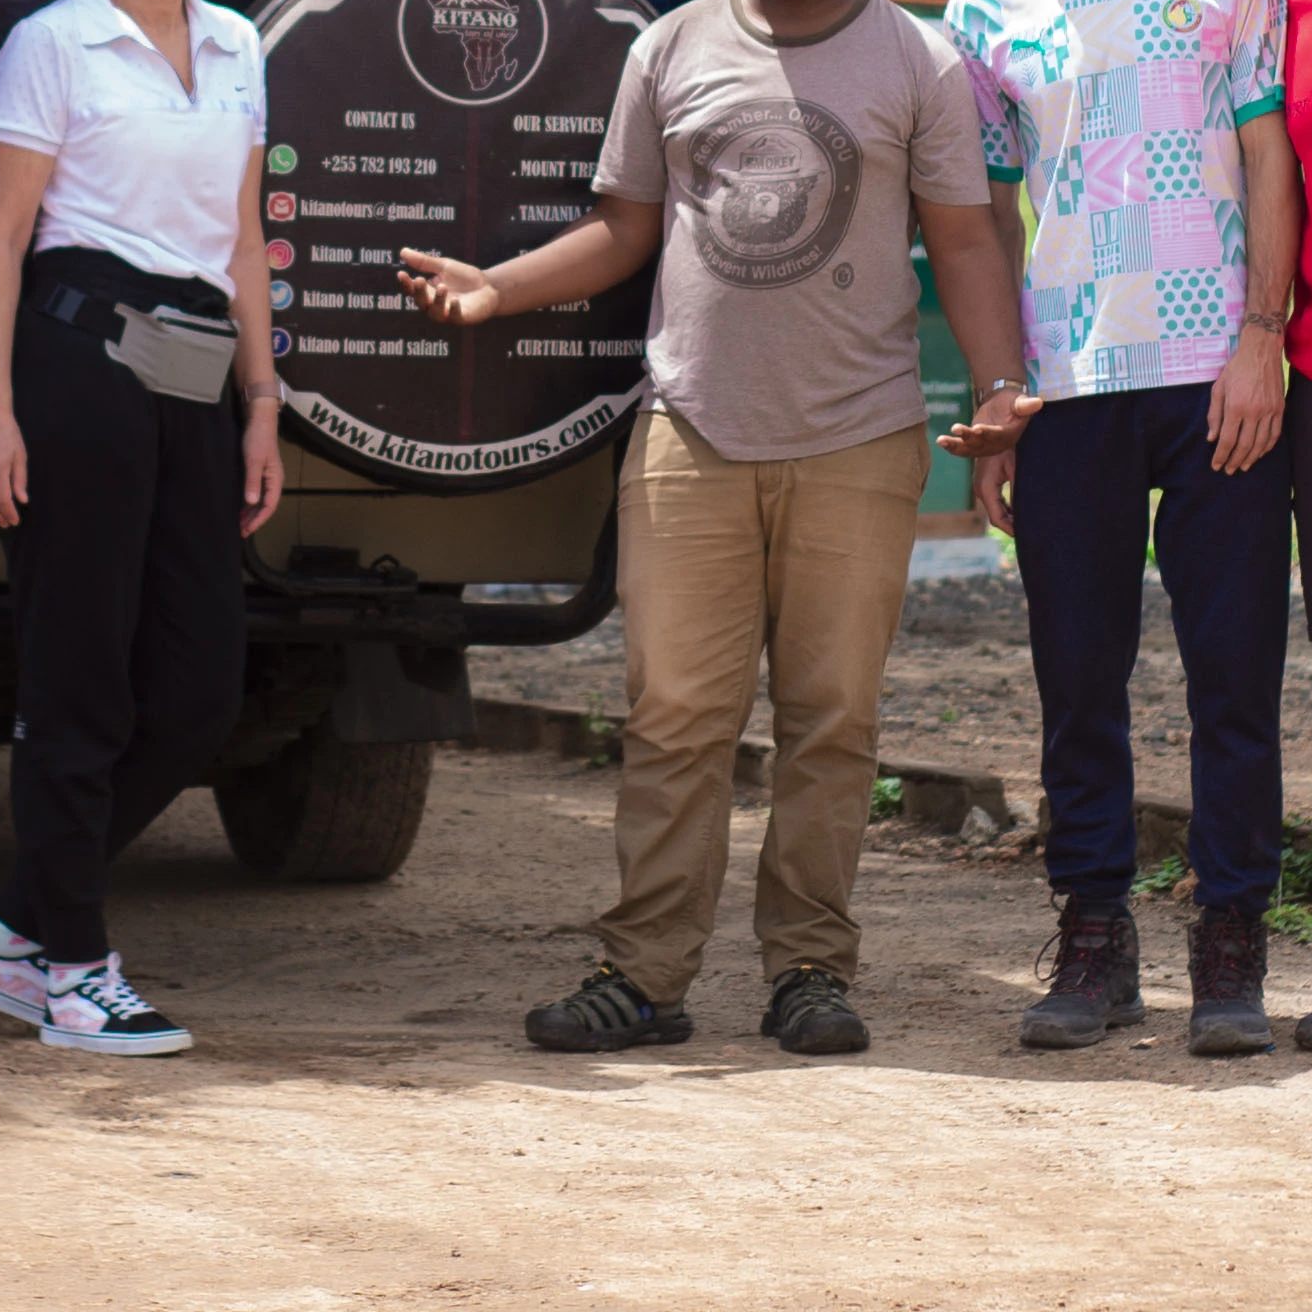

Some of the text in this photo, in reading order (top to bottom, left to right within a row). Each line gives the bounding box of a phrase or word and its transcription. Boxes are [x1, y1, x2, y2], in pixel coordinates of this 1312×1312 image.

[433, 9, 517, 28] KITANO
[344, 109, 416, 129] CONTACT US
[513, 115, 605, 134] OUR SERVICES
[789, 107, 824, 133] Only
[825, 124, 854, 163] YOU
[321, 155, 437, 175] +255 782 193 210
[520, 159, 565, 177] MOUNT
[519, 205, 581, 222] TANZANIA
[703, 242, 824, 280] Prevent Wildfires!
[303, 290, 344, 308] kitano
[347, 292, 374, 309] tous
[377, 293, 402, 310] and
[298, 335, 449, 357] kitano tours and safaris
[517, 339, 584, 357] CURTURAL
[309, 401, 616, 472] www.kitanotours.com
